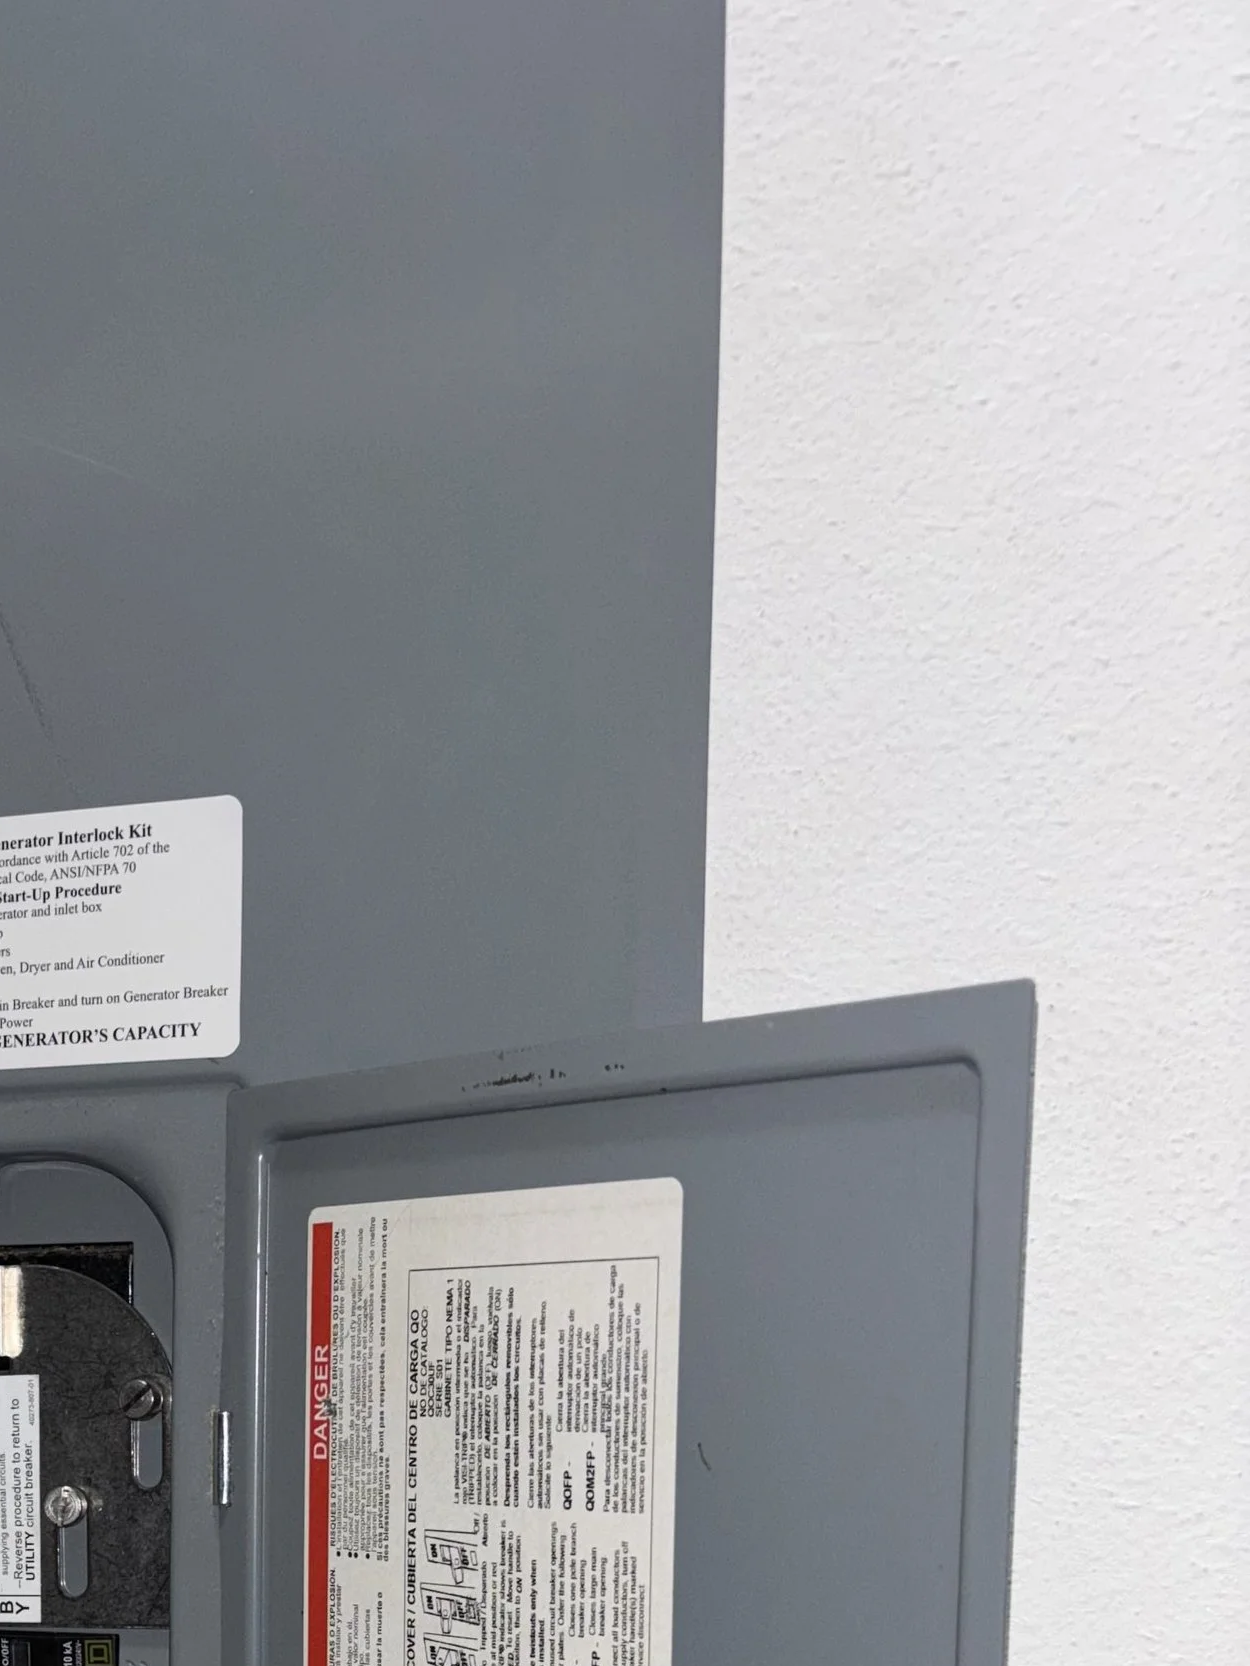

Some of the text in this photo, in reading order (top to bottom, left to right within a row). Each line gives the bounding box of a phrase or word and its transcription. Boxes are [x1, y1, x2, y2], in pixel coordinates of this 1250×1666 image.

[57, 825, 125, 846] Interlock
[128, 823, 153, 840] Kit
[44, 849, 69, 864] with
[70, 846, 110, 862] Article
[112, 843, 134, 858] 702
[136, 842, 151, 856] of
[152, 841, 171, 854] the
[14, 869, 48, 884] Code,
[49, 862, 120, 881] ANSI/NFPA
[121, 860, 137, 874] 70
[54, 882, 123, 900] Procedure
[30, 904, 51, 918] and
[53, 903, 79, 916] inlet
[81, 902, 103, 914] box
[19, 961, 52, 976] Dryer
[53, 957, 75, 972] and
[75, 956, 96, 970] Air
[97, 952, 165, 968] Conditioner
[12, 996, 56, 1011] Breaker
[57, 994, 78, 1008] and
[80, 995, 104, 1007] turn
[106, 994, 121, 1005] on
[123, 989, 181, 1004] Generator
[183, 984, 229, 999] Breaker
[112, 1021, 202, 1042] CAPACITY
[408, 1304, 420, 1338] QO
[408, 1337, 420, 1395] CARGA
[10, 1398, 20, 1411] to
[314, 1345, 328, 1460] DANGER
[408, 1399, 419, 1421] DE
[10, 1413, 21, 1449] return
[10, 1451, 22, 1464] to
[407, 1424, 418, 1489] CENTRO
[11, 1466, 24, 1528] procedure
[407, 1492, 418, 1524] DEL
[23, 1440, 36, 1582] UTILITY circuit breaker.
[406, 1527, 417, 1606] CUBIERTA
[62, 1641, 73, 1666] 10 kA
